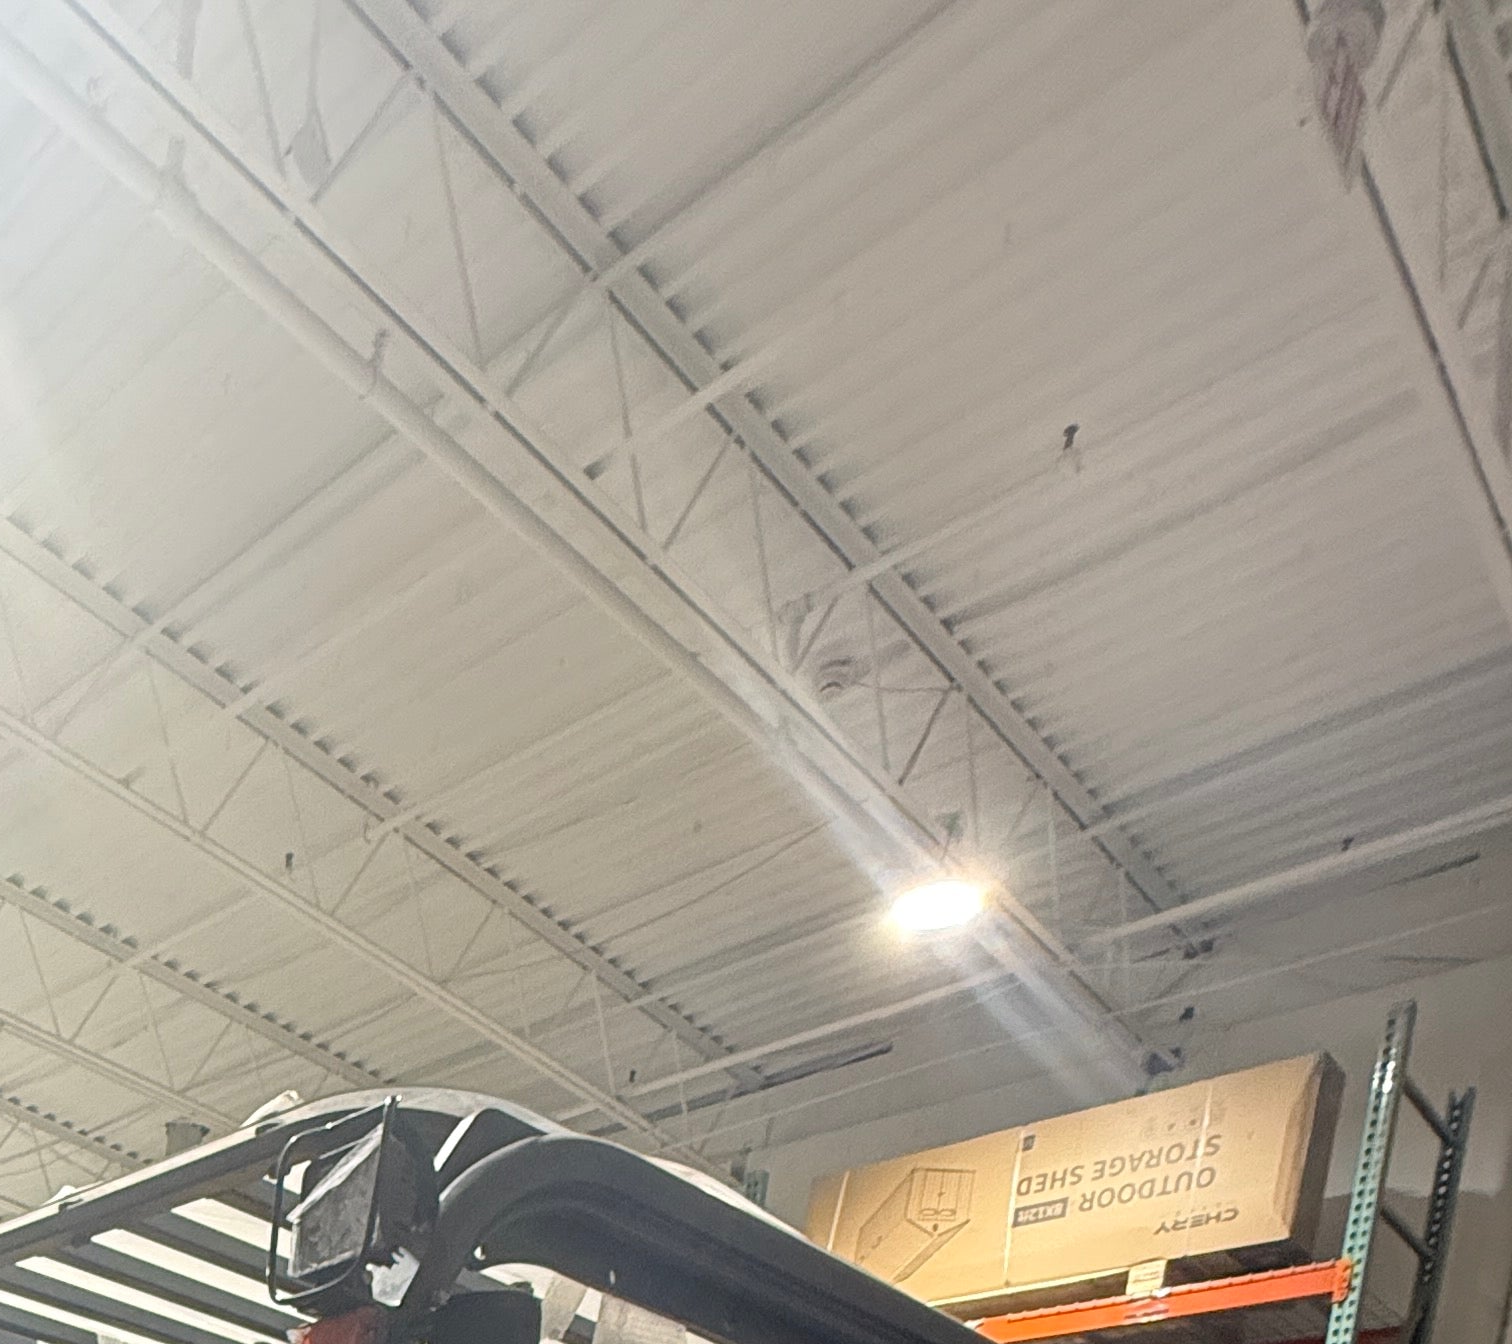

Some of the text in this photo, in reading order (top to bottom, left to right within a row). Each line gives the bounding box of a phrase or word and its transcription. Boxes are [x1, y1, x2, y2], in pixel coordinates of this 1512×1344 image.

[1016, 1134, 1223, 1197] STORAGE SHED
[1078, 1166, 1217, 1212] OUTDOOR
[1153, 1206, 1240, 1235] CHERY
